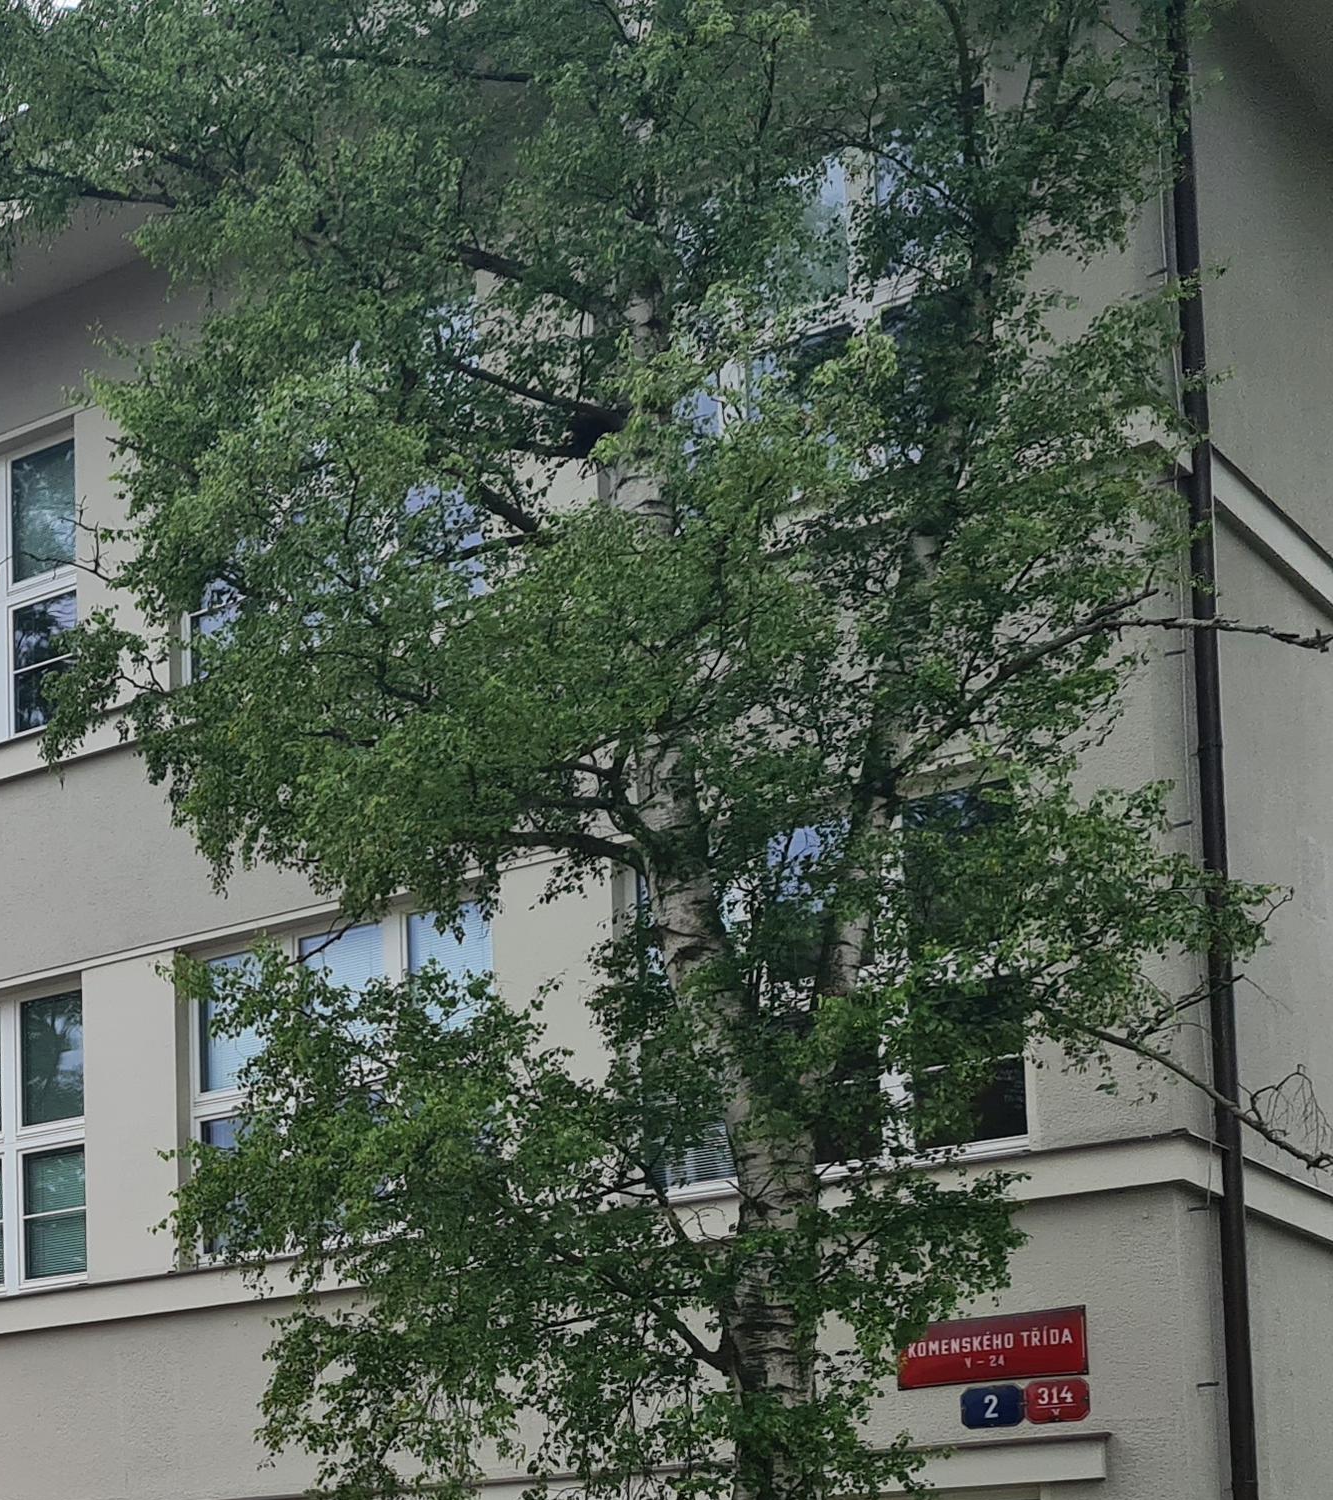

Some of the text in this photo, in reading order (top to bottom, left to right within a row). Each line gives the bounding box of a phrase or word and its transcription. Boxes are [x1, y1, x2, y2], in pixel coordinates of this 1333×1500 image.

[908, 1325, 1073, 1358] KOMENSKÉHO TŘÍDA
[988, 1354, 1005, 1367] 24
[1037, 1385, 1073, 1404] 314
[983, 1394, 999, 1418] 2
